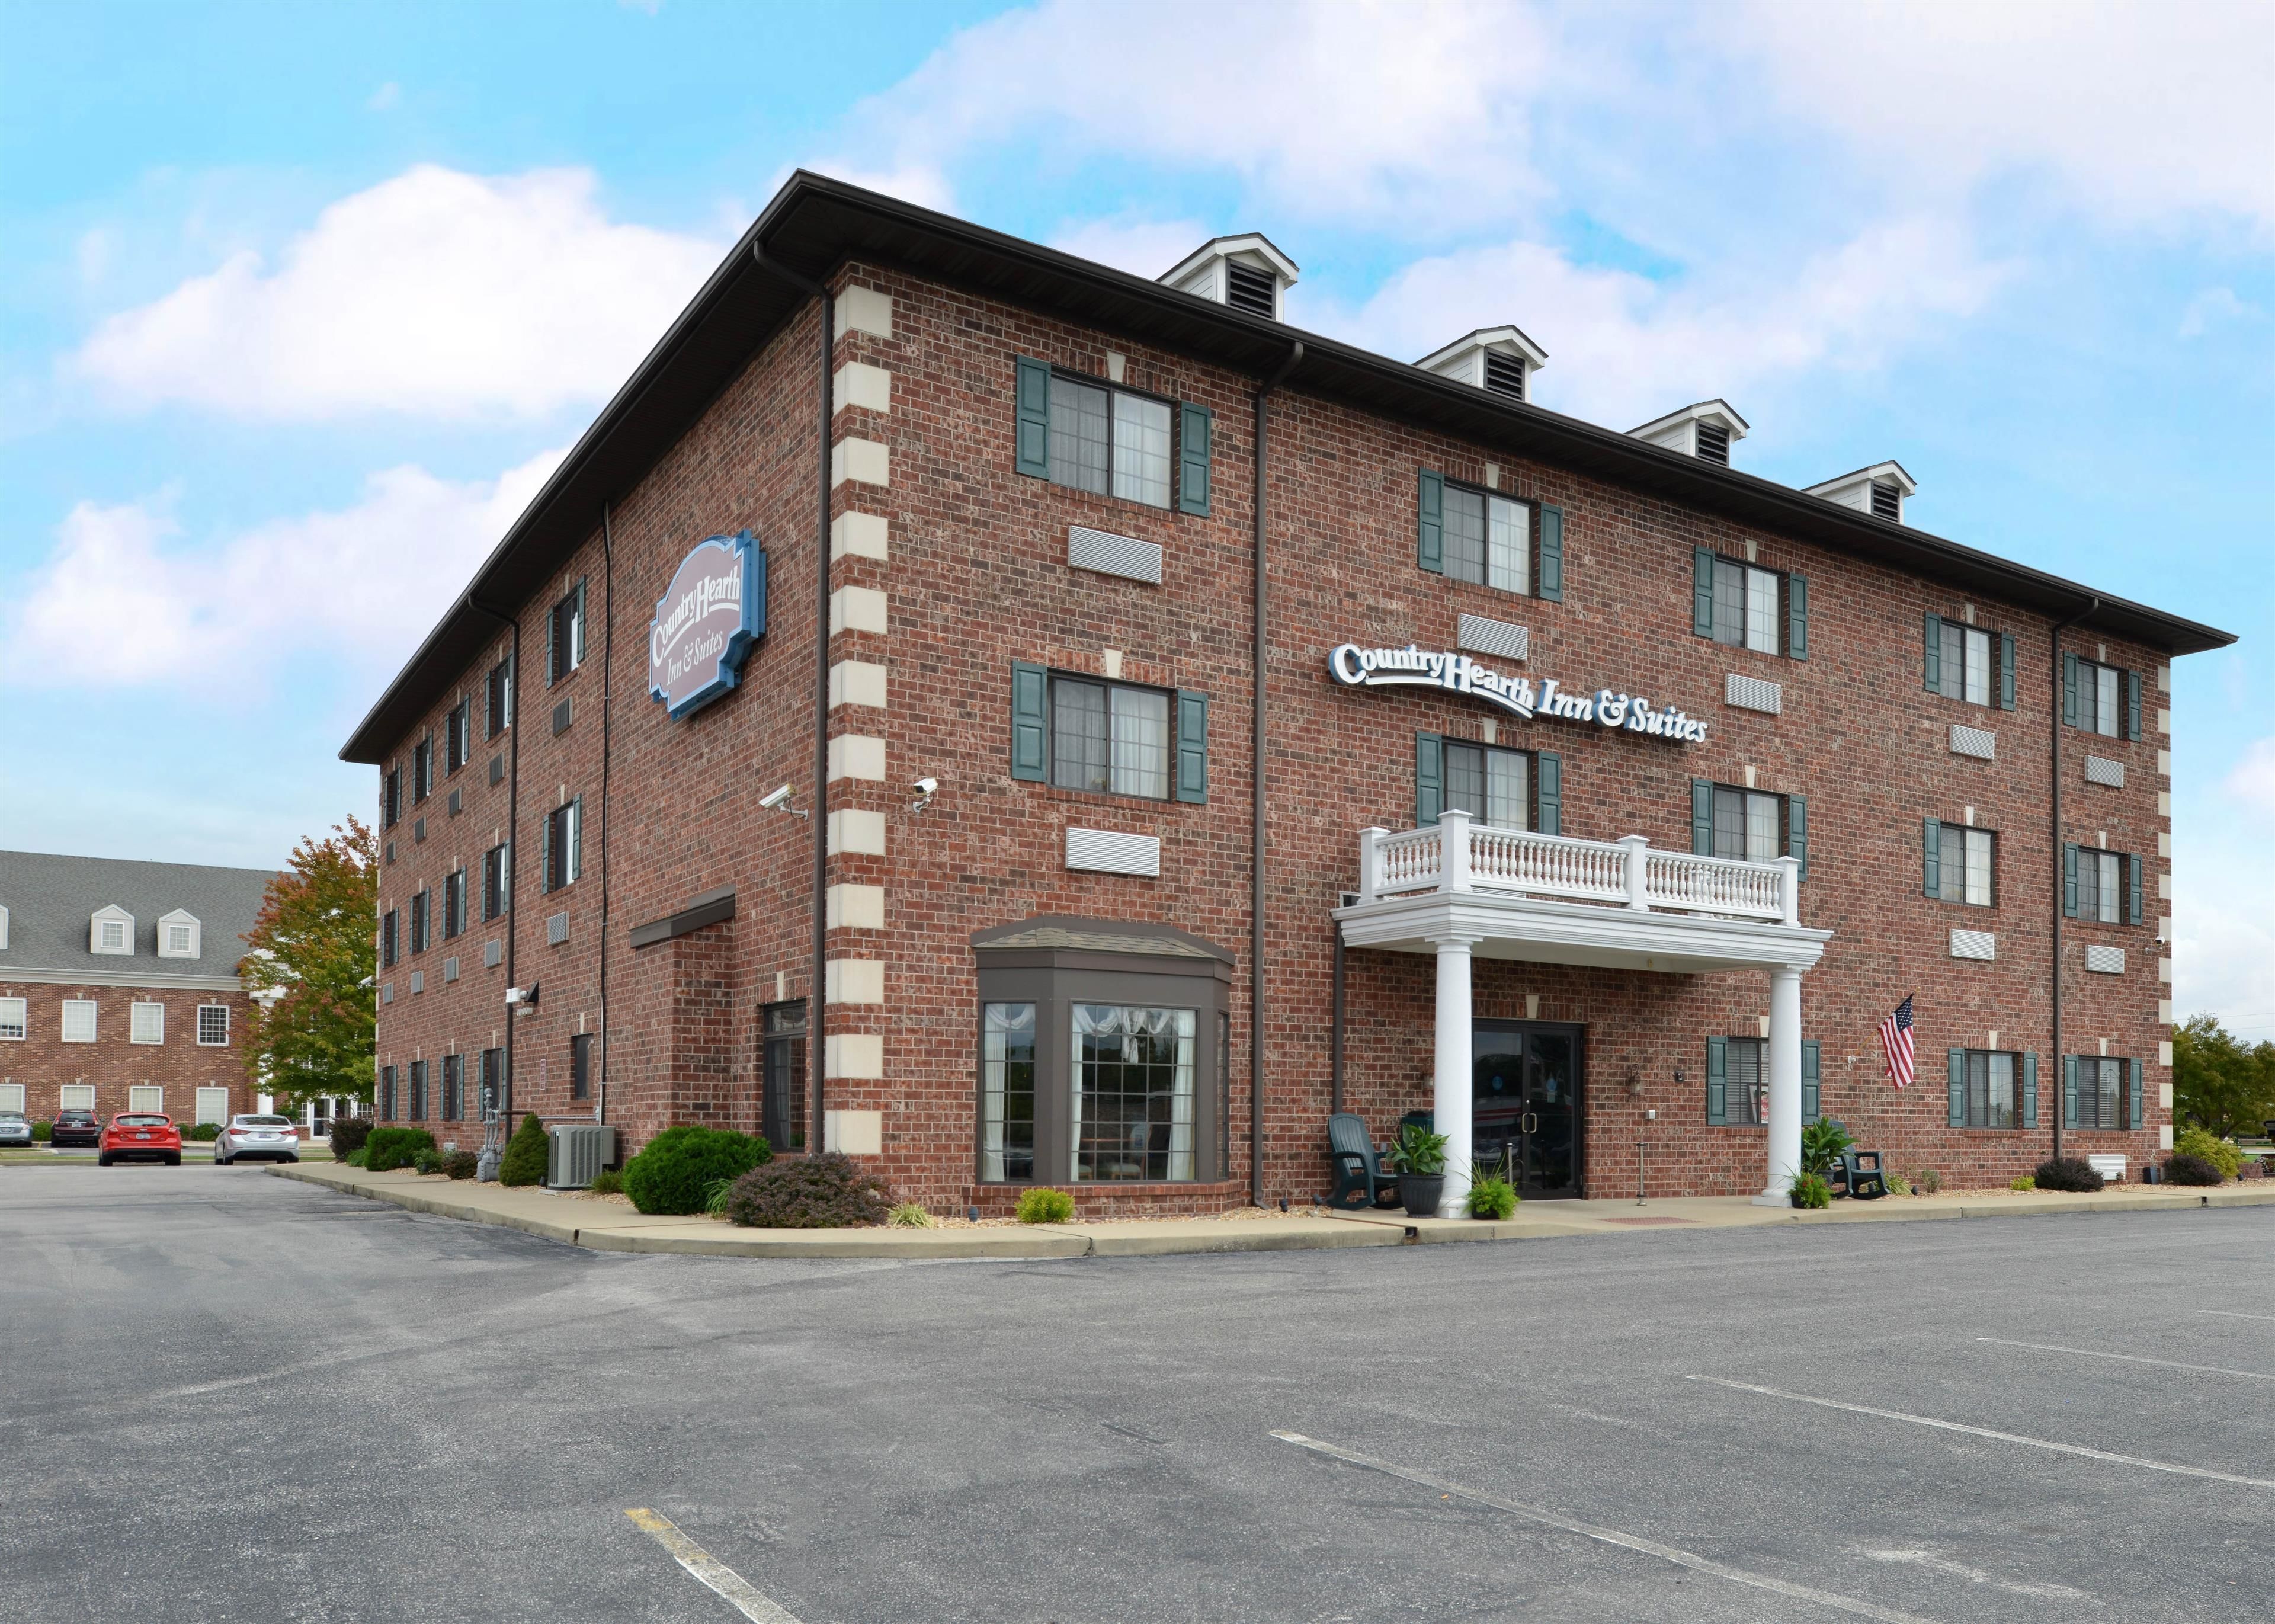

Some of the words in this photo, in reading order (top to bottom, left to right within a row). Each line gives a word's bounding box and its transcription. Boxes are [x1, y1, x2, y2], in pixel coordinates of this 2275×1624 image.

[667, 658, 682, 686] Inn
[684, 642, 694, 672] &
[694, 629, 723, 665] Suites
[1536, 678, 1593, 721] Inn
[1597, 689, 1629, 727] &
[1627, 697, 1708, 743] Suites
